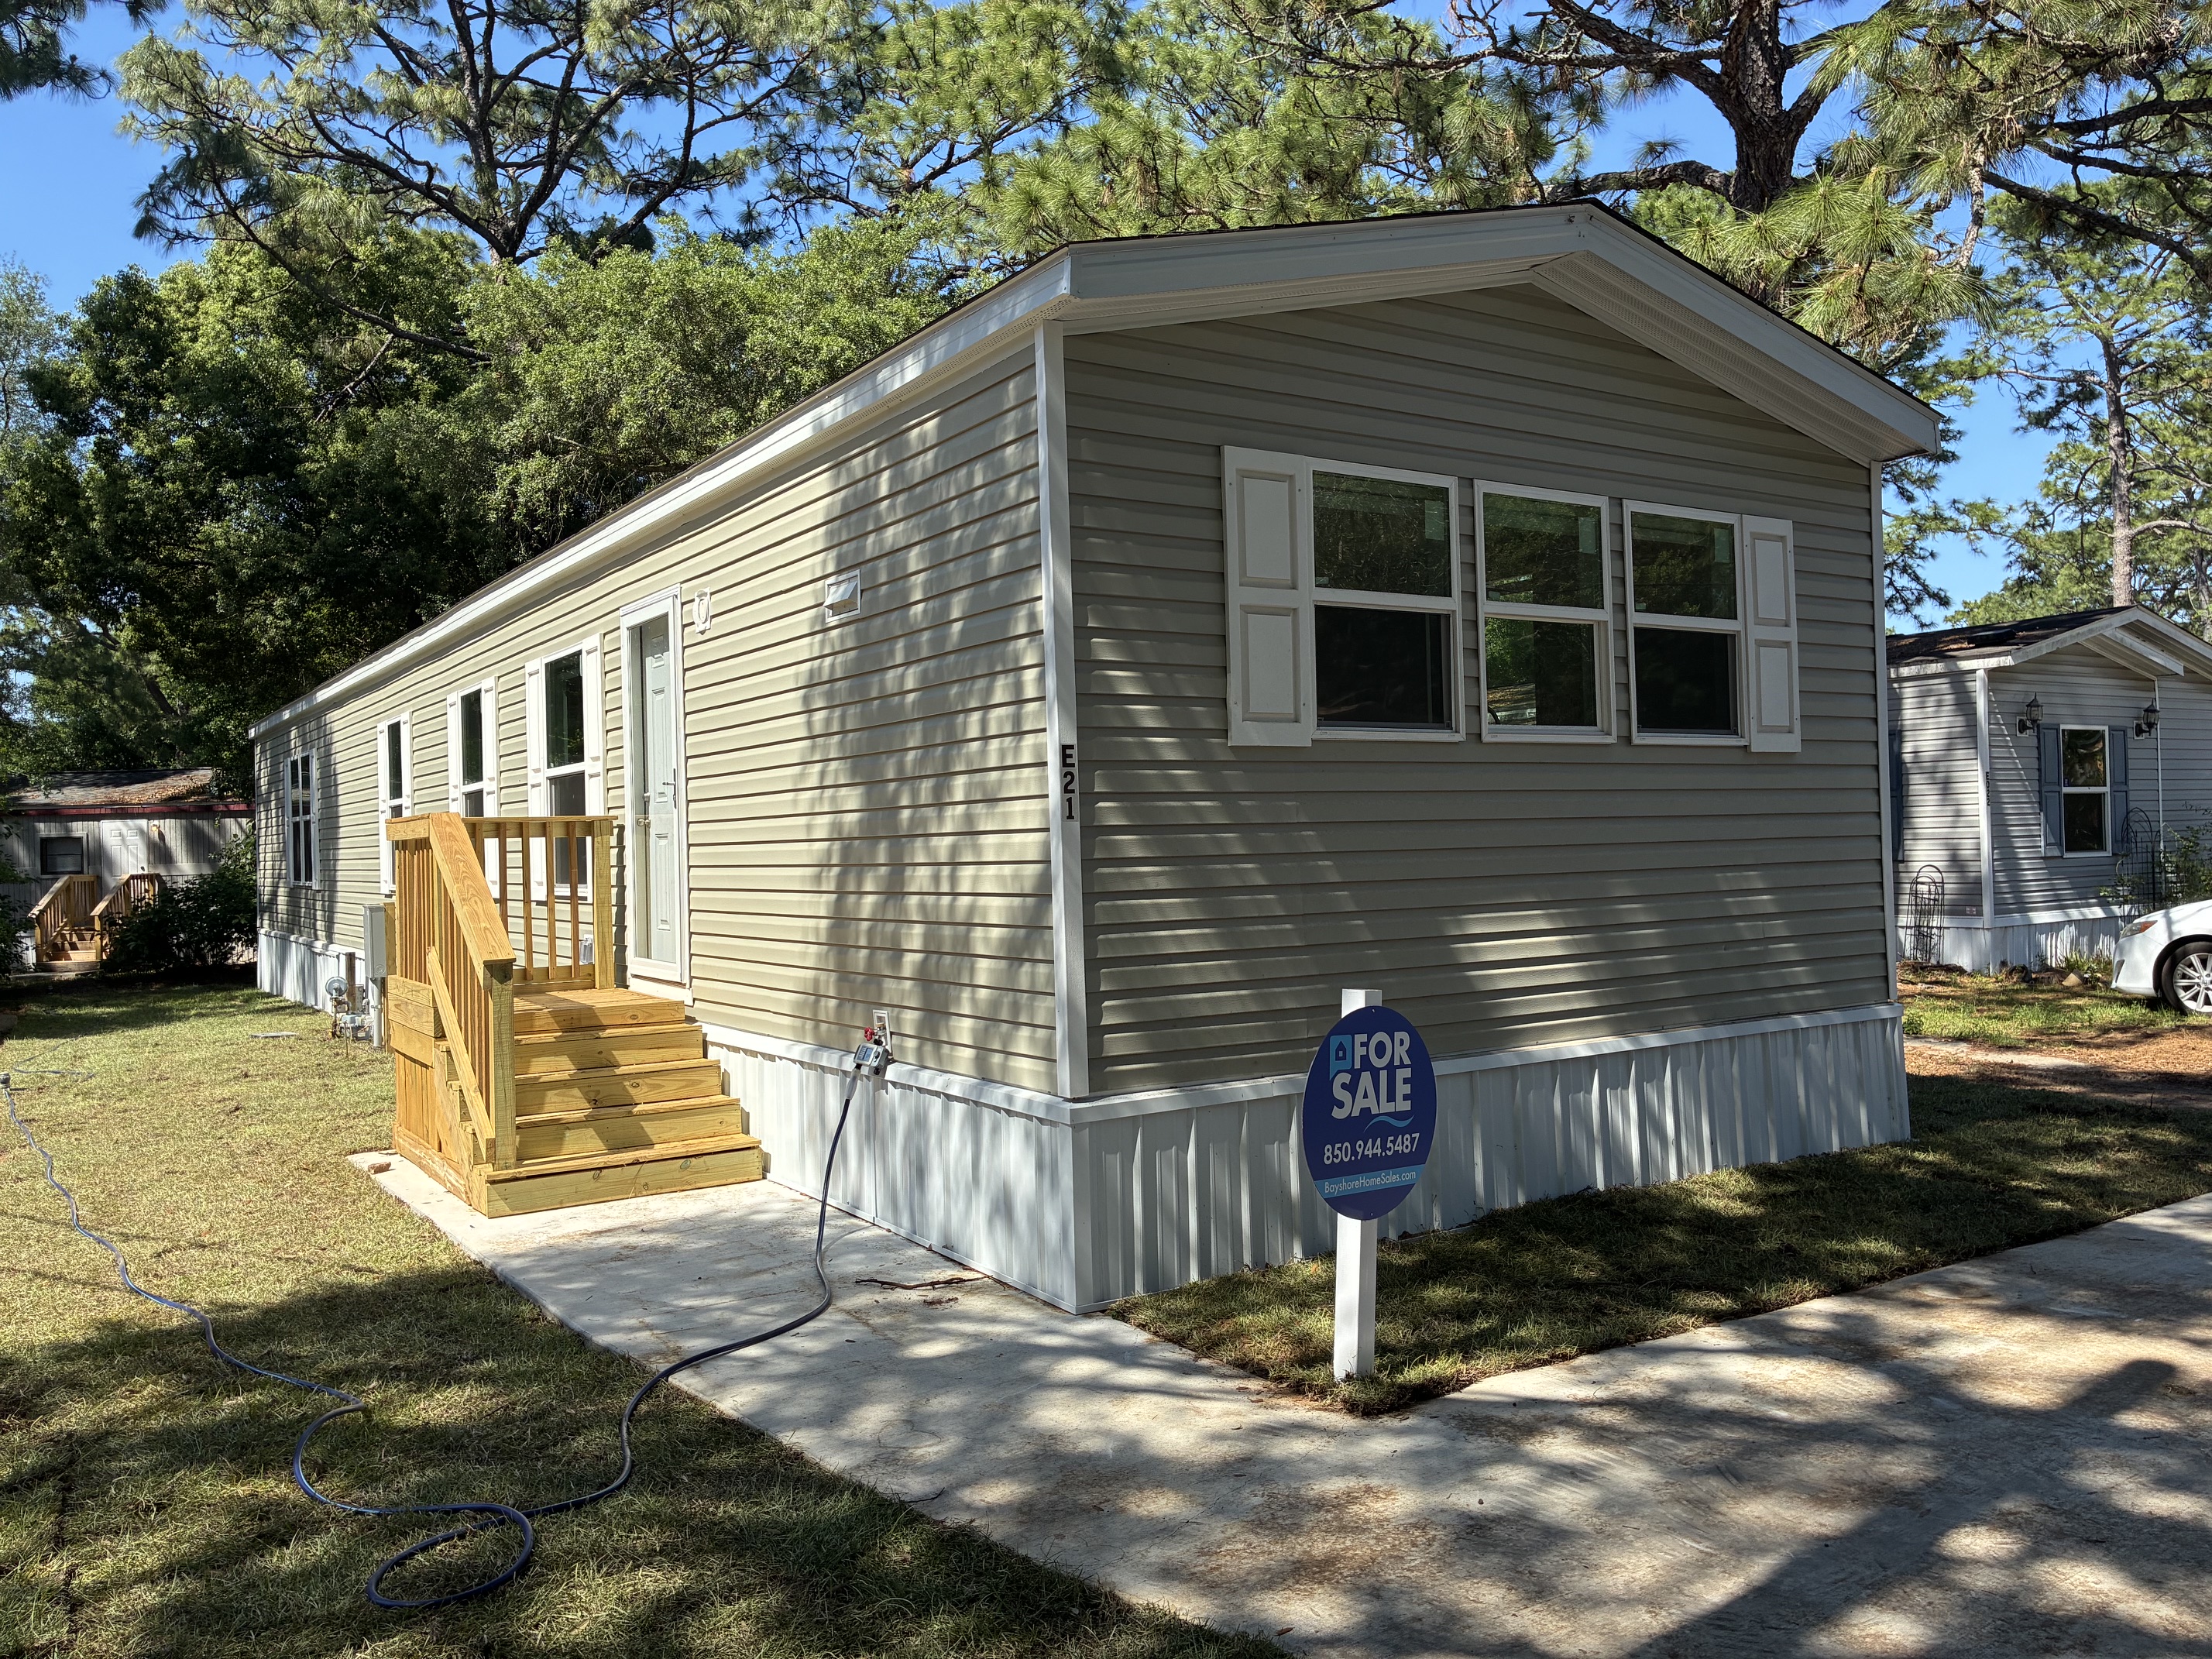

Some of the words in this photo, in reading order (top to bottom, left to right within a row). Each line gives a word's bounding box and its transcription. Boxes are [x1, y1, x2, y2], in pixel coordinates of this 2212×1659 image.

[1061, 744, 1076, 820] E21
[1354, 1031, 1412, 1069] FOR
[1331, 1067, 1412, 1119] SALE
[1324, 1132, 1420, 1165] 850.944.5487
[1324, 1170, 1417, 1195] BayshoreHomeSales.com
